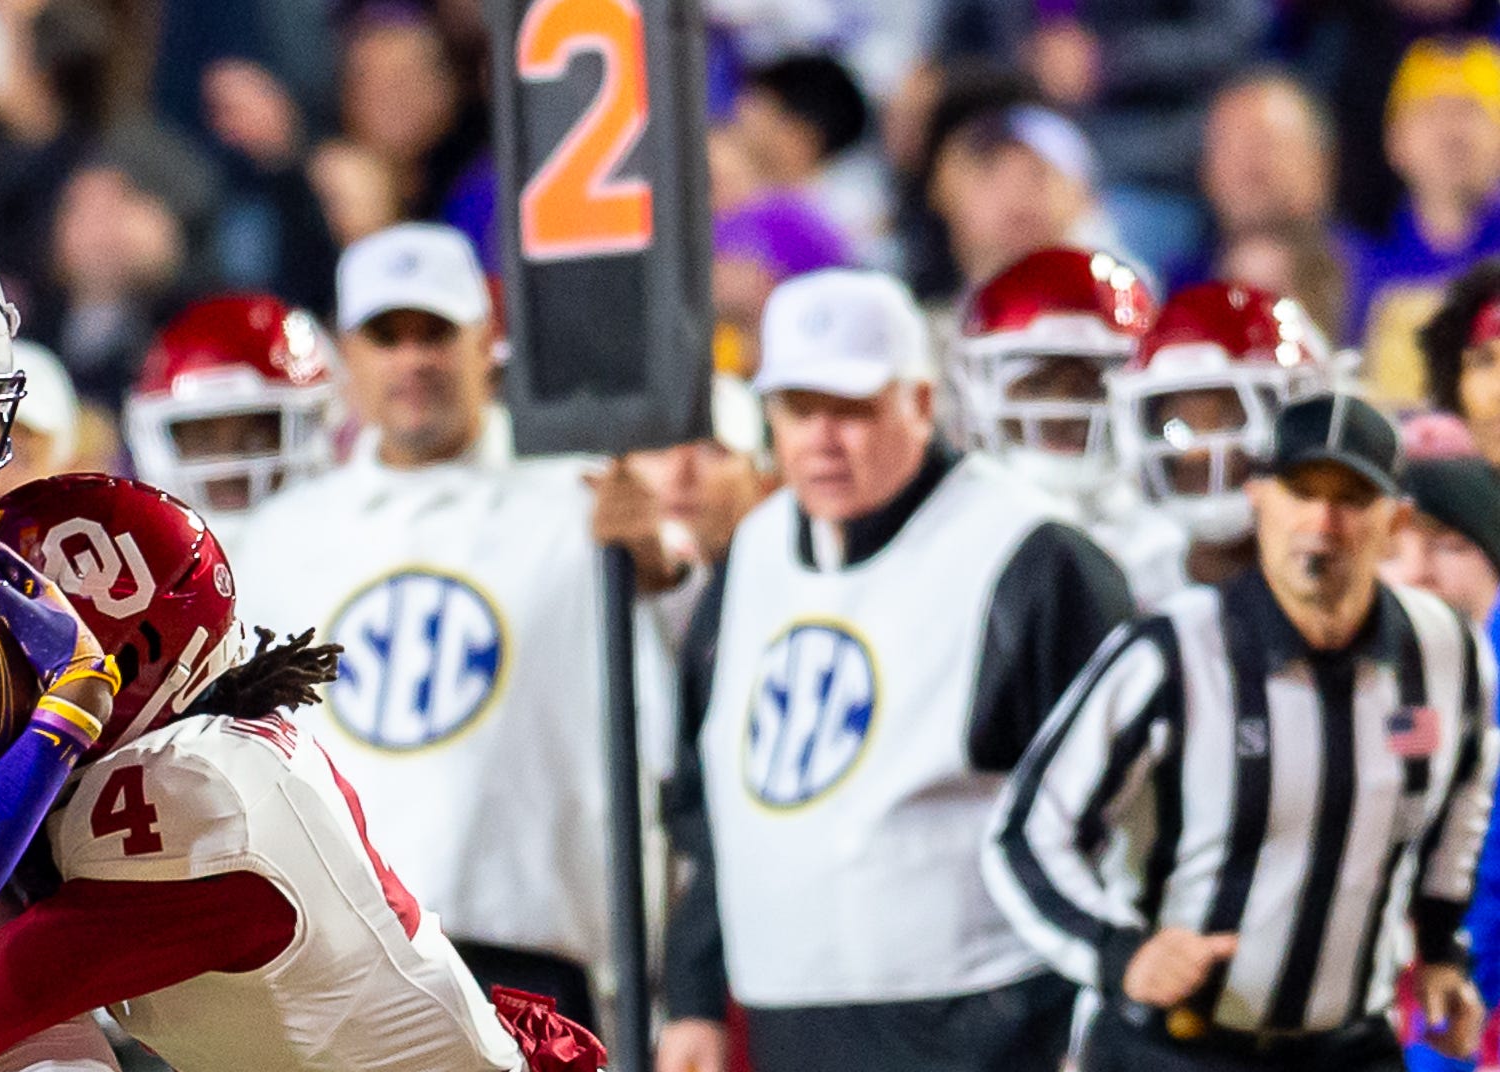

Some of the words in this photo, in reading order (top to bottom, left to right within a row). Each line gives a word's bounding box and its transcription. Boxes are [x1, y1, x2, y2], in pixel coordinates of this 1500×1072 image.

[517, 0, 654, 259] 2
[41, 517, 157, 619] OU
[332, 572, 498, 749] SEC
[750, 624, 874, 805] SEC
[90, 764, 163, 856] 4
